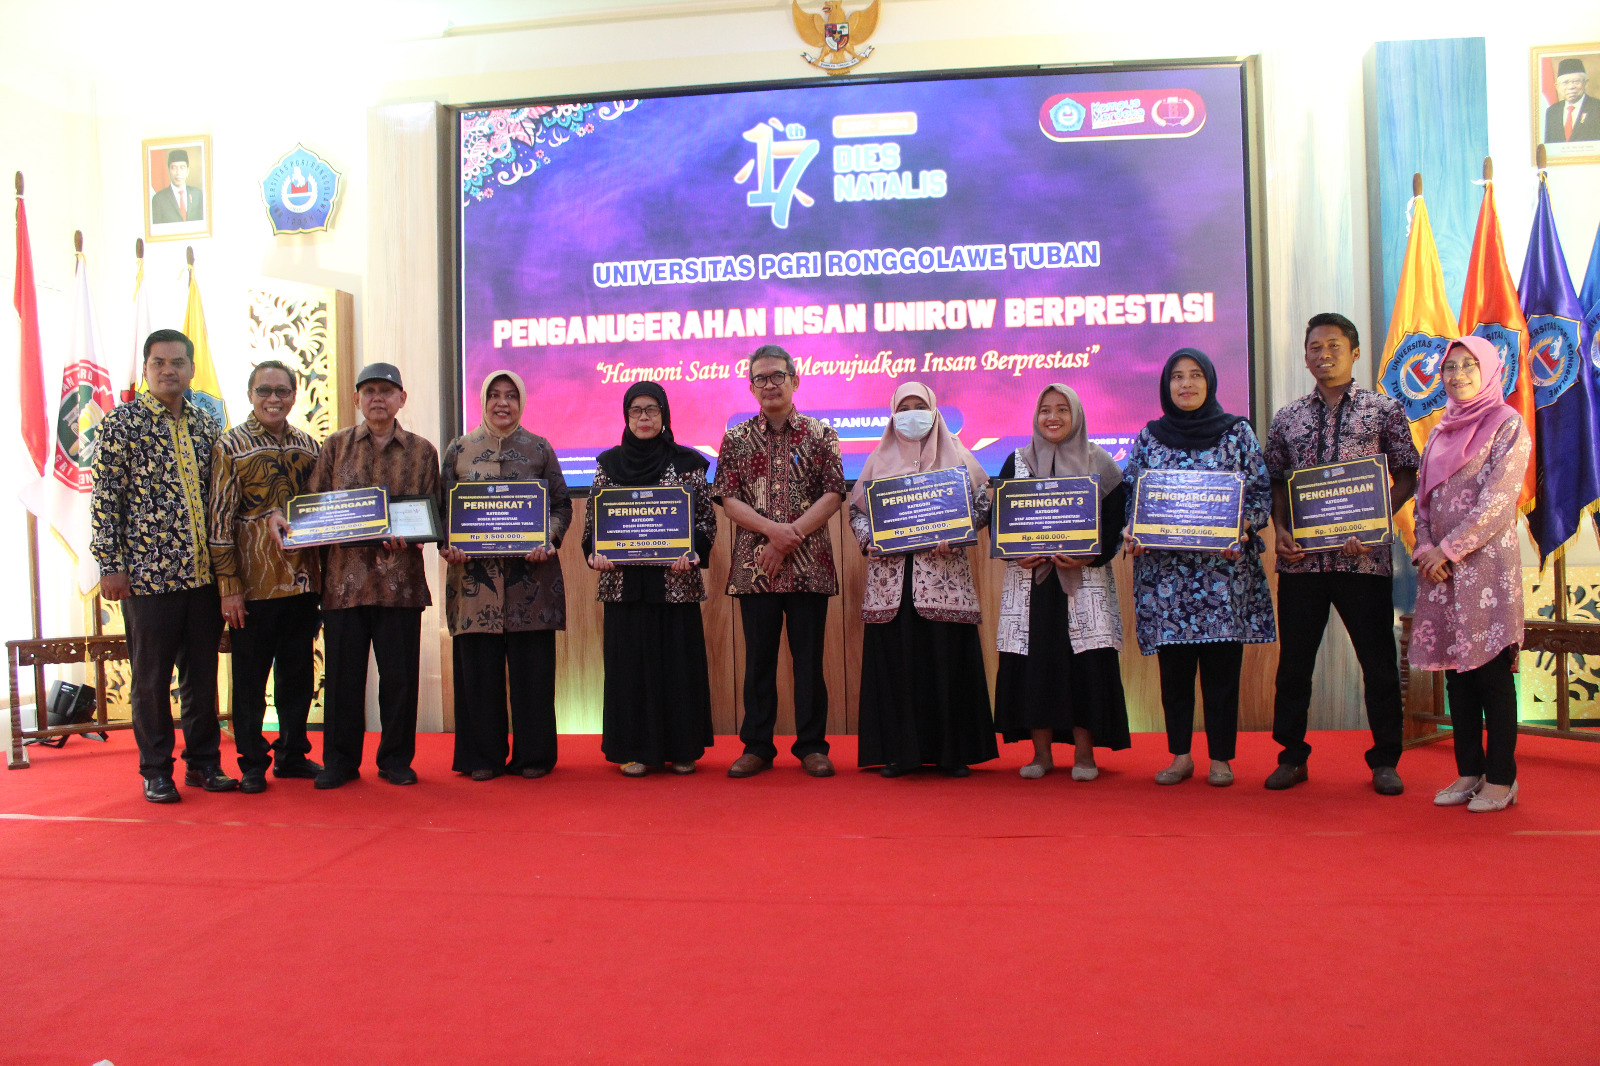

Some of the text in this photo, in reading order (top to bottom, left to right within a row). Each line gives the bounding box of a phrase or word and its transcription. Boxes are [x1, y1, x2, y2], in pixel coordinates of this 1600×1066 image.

[833, 143, 901, 173] DIES
[833, 169, 948, 203] NATALIS
[593, 240, 1101, 288] UNIVERSITAS PGRI RONGGOLAWE TUBAN
[493, 292, 1215, 348] PENGANUGERAHAN INSAN UNIROW BERPRESTASI
[1391, 340, 1432, 371] UNIVERSITAS
[685, 360, 730, 382] Satu
[792, 351, 917, 382] Mewujudkan
[921, 352, 977, 373] Insan
[833, 416, 891, 428] JANUAR
[882, 489, 944, 507] PERINGKAT
[946, 488, 954, 496] 3
[1147, 491, 1230, 503] PENGHARGAAN
[1299, 482, 1374, 502] PENGHARGAAN
[298, 500, 376, 514] PENGHARGAAN
[463, 501, 532, 510] PERINGKAT 1
[608, 506, 678, 517] PERINGKAT 2
[1010, 496, 1084, 509] PERINGKAT 3
